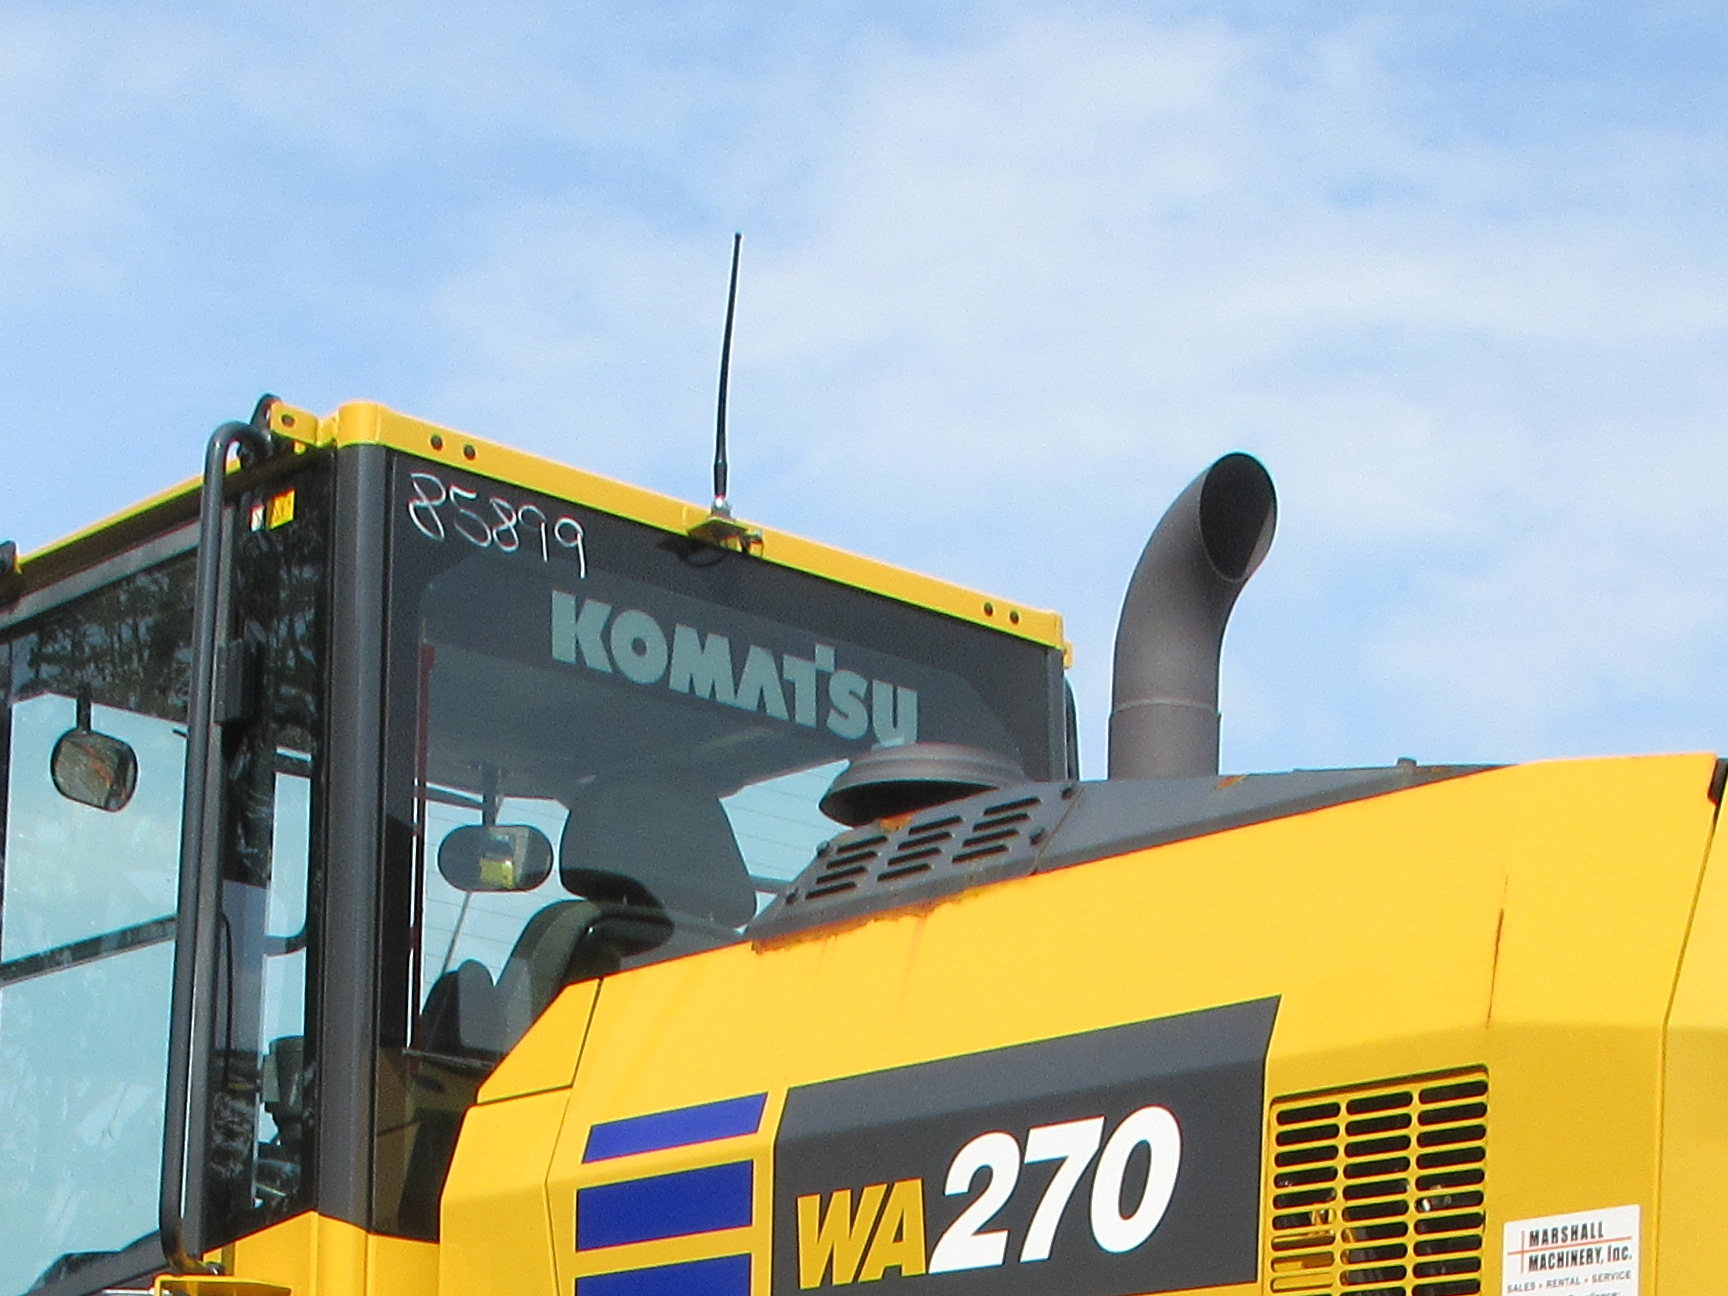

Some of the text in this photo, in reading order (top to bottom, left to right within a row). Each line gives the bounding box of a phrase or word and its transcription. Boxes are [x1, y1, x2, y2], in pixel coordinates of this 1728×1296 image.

[406, 472, 589, 579] 85899
[549, 590, 920, 747] KOMATSU
[796, 1104, 1183, 1291] WA270
[1528, 1244, 1632, 1272] MACHINERY, Inc.
[1529, 1221, 1604, 1247] MARSHALL
[1507, 1270, 1631, 1294] SALES RENTAL SERVICE
